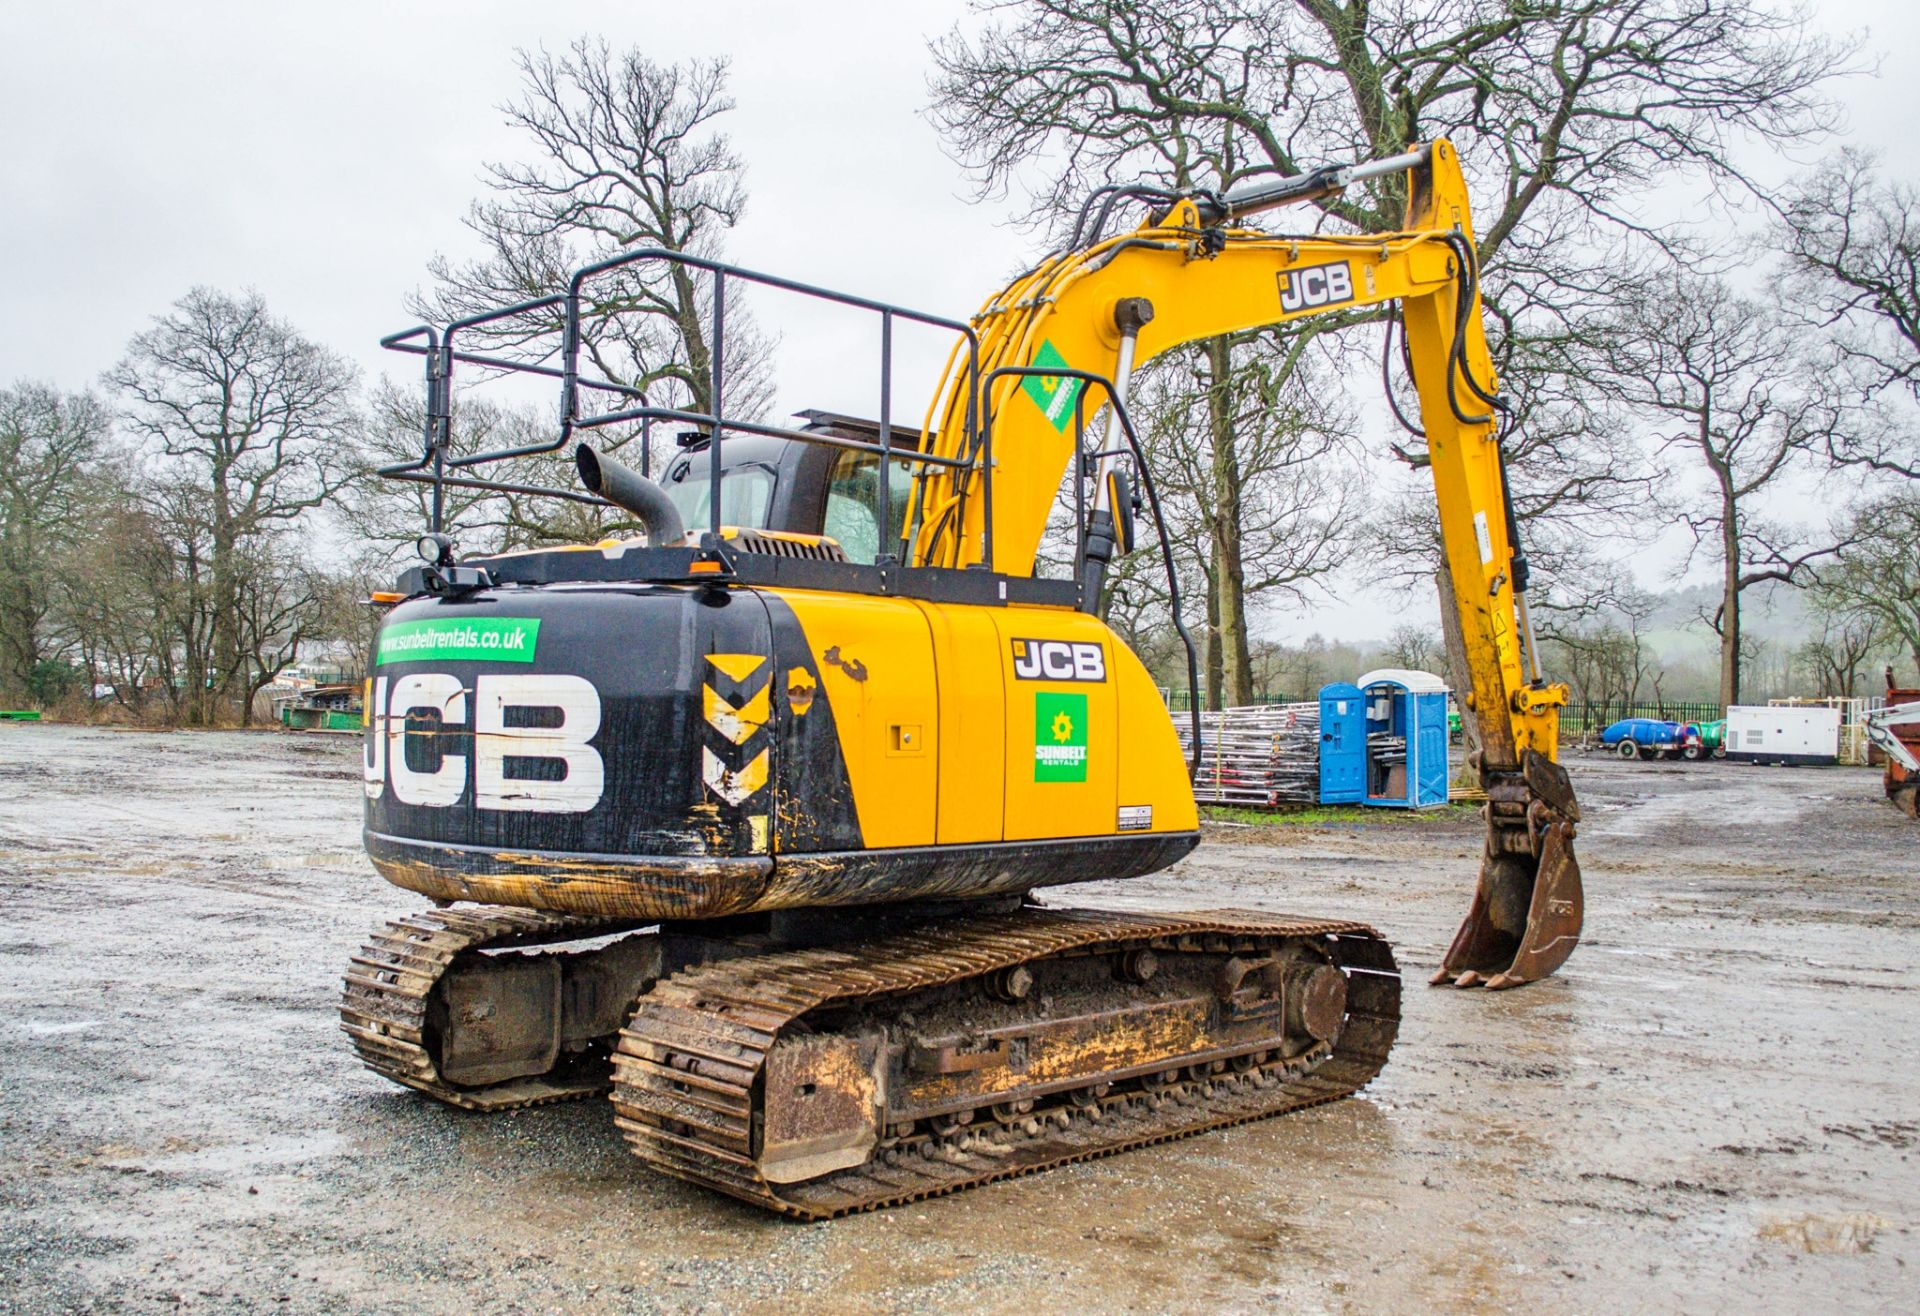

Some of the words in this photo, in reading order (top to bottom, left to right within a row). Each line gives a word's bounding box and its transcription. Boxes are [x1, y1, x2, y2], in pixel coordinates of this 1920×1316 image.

[1281, 264, 1352, 310] JCB
[381, 626, 526, 653] www.sunbeltrentals.co.uk
[1015, 640, 1105, 680] JCB
[1035, 745, 1086, 760] SUNBELT
